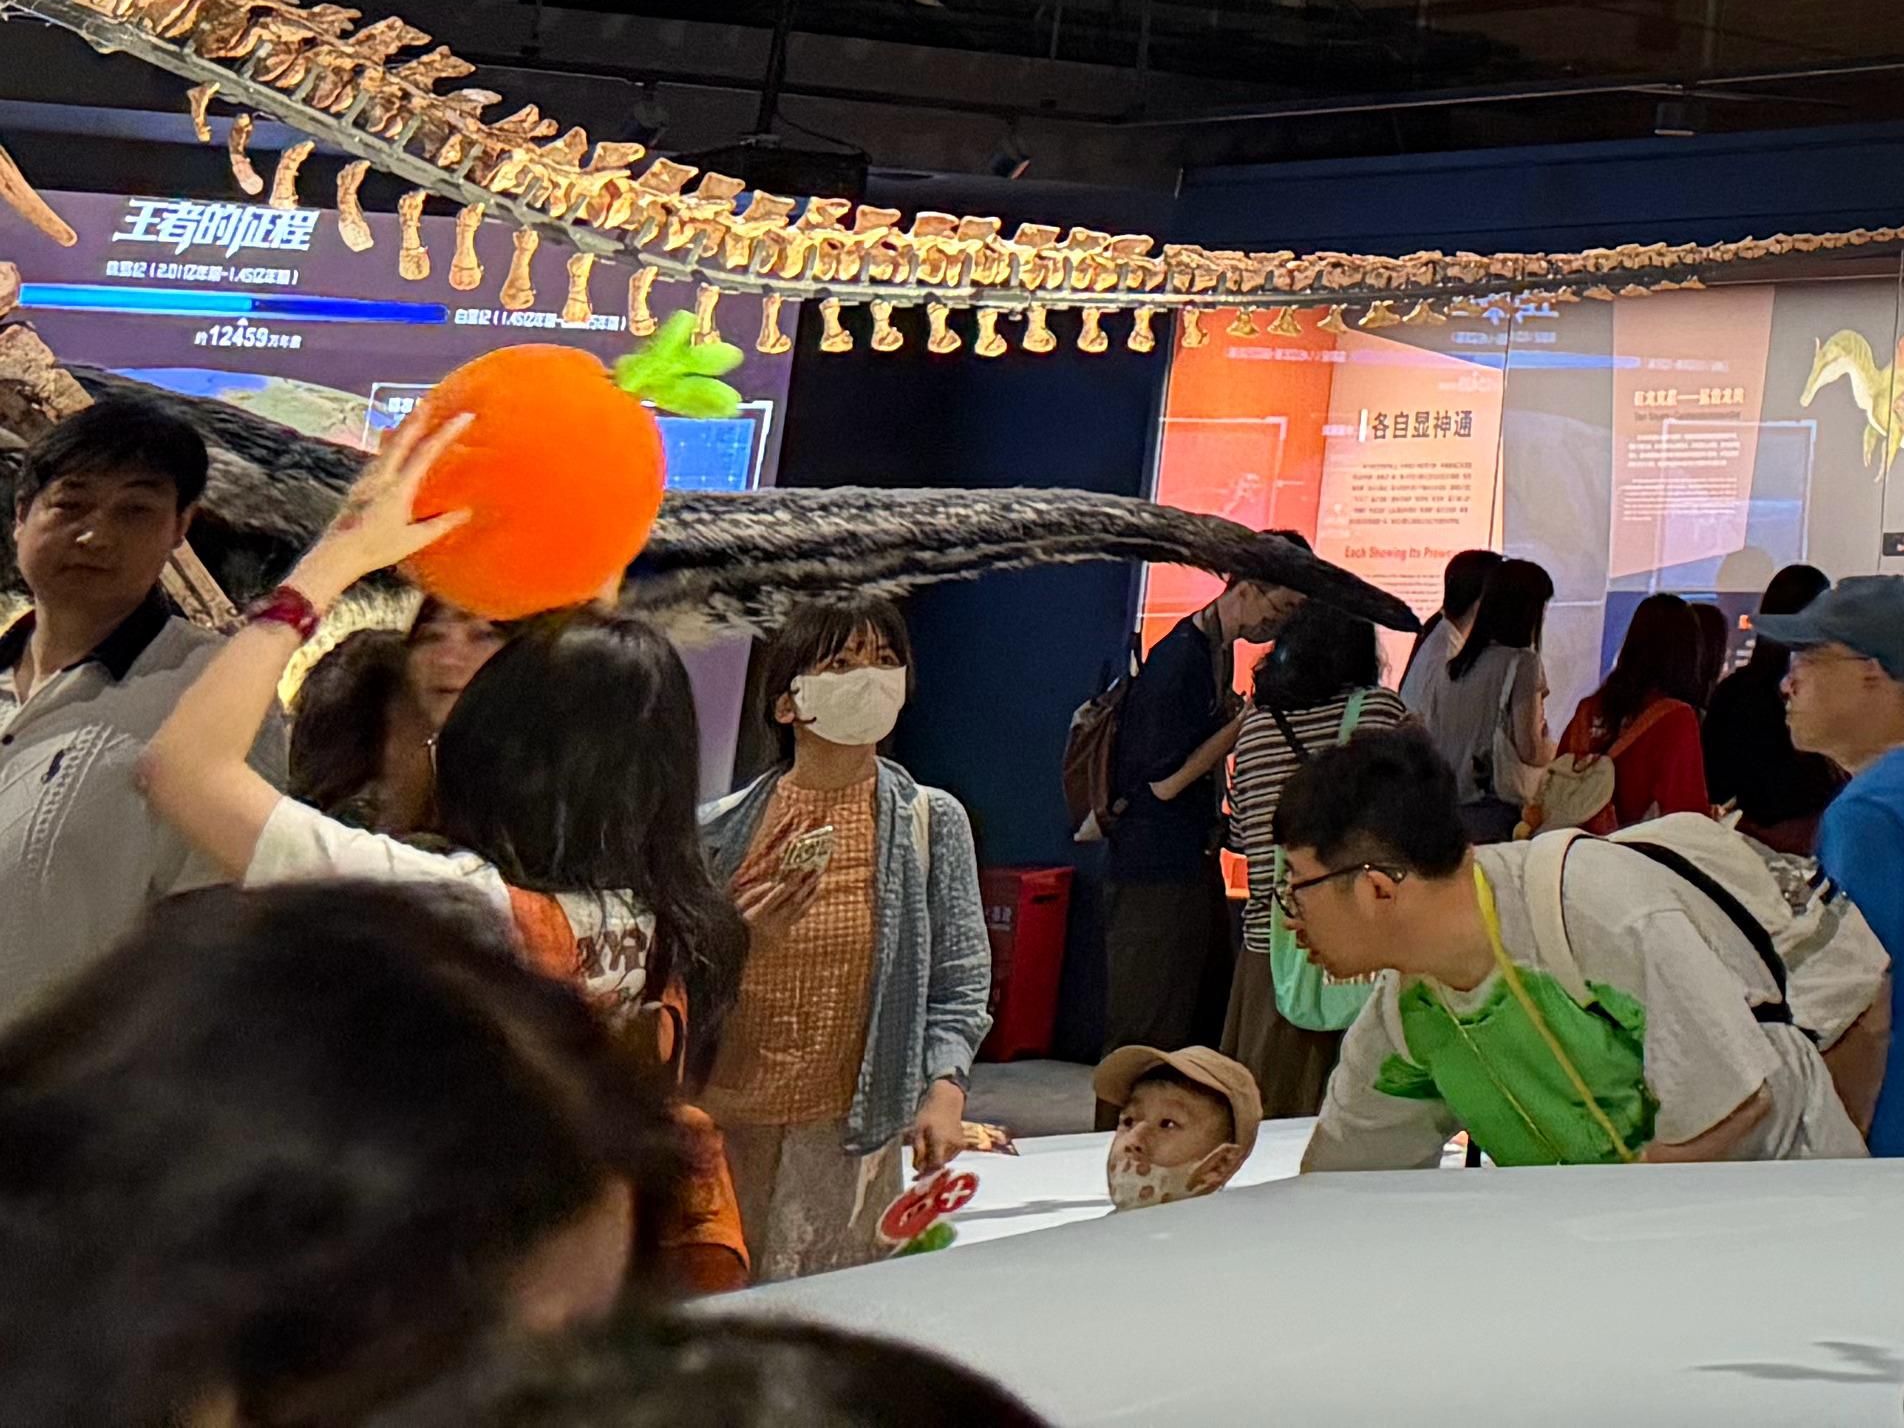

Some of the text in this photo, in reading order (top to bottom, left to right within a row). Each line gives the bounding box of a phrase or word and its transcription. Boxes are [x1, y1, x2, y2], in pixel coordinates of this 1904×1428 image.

[112, 198, 320, 258] 王者的征程
[1372, 410, 1473, 440] 各自显神通
